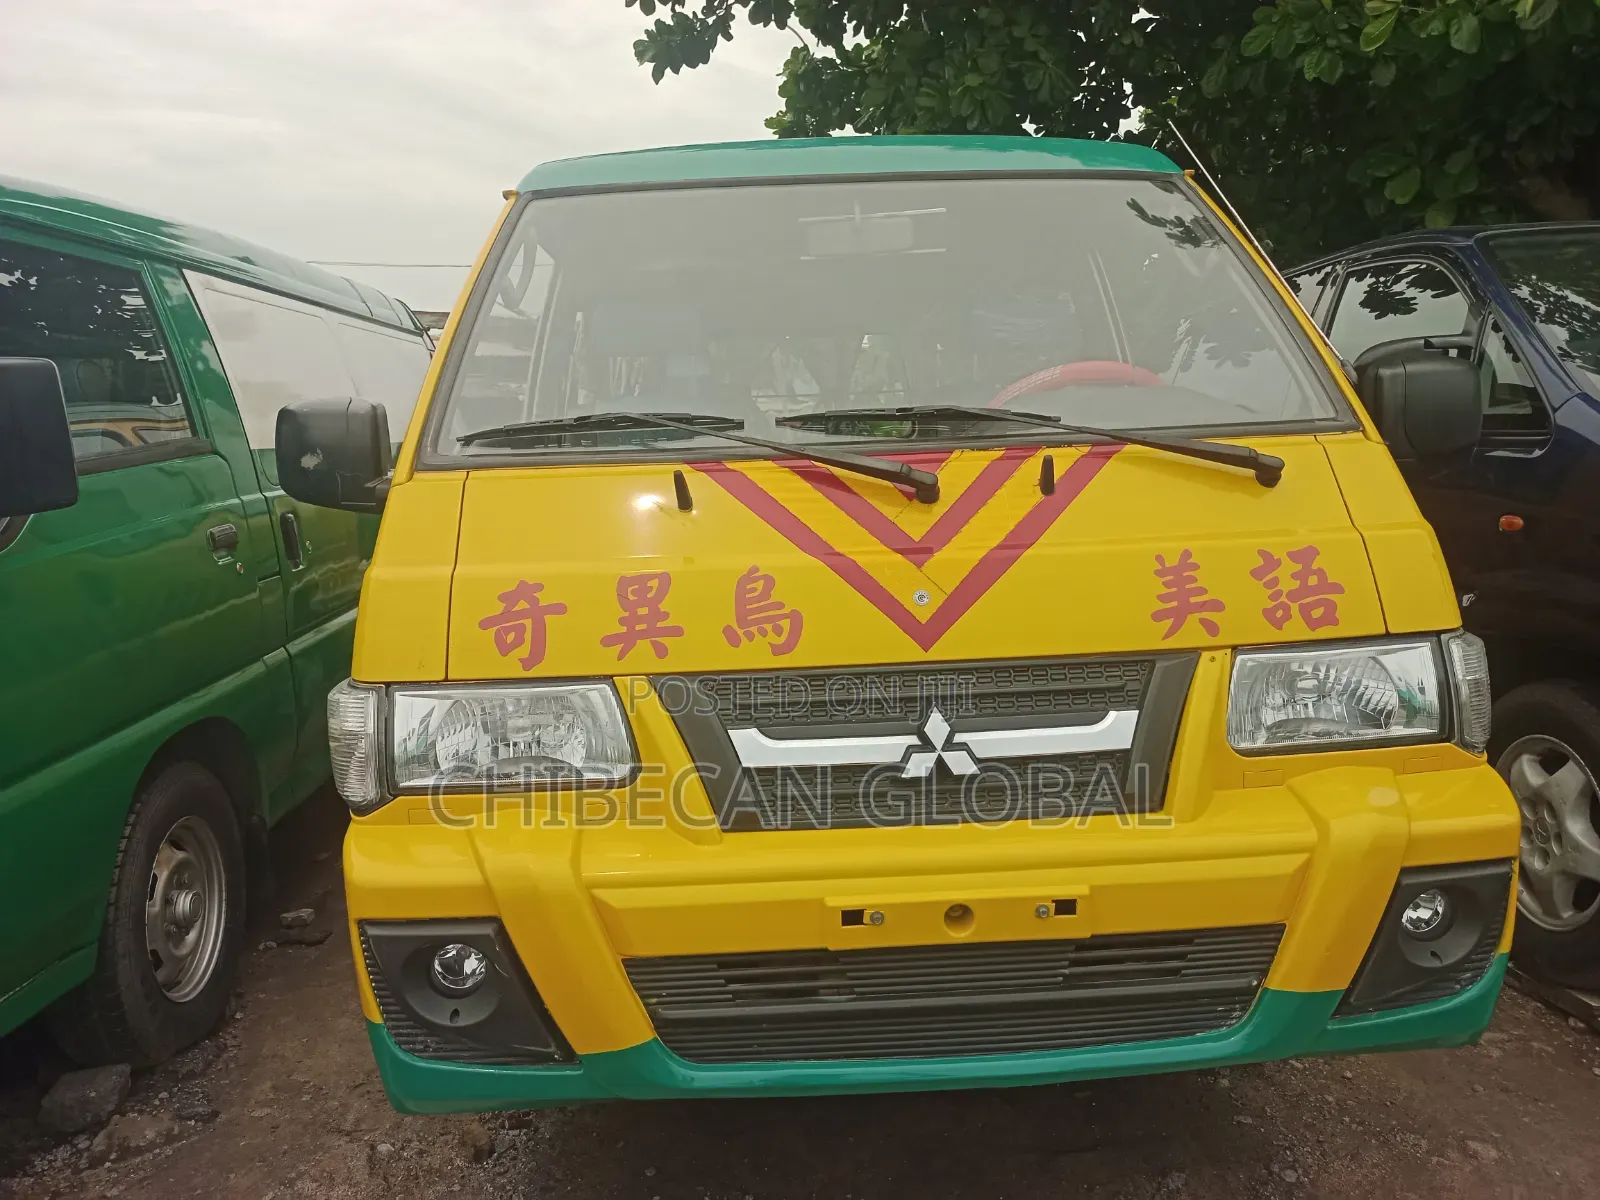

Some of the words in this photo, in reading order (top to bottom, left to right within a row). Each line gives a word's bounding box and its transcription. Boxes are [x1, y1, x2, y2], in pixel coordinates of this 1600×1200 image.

[478, 564, 804, 672] 奇異鳥
[1151, 545, 1345, 641] 美語
